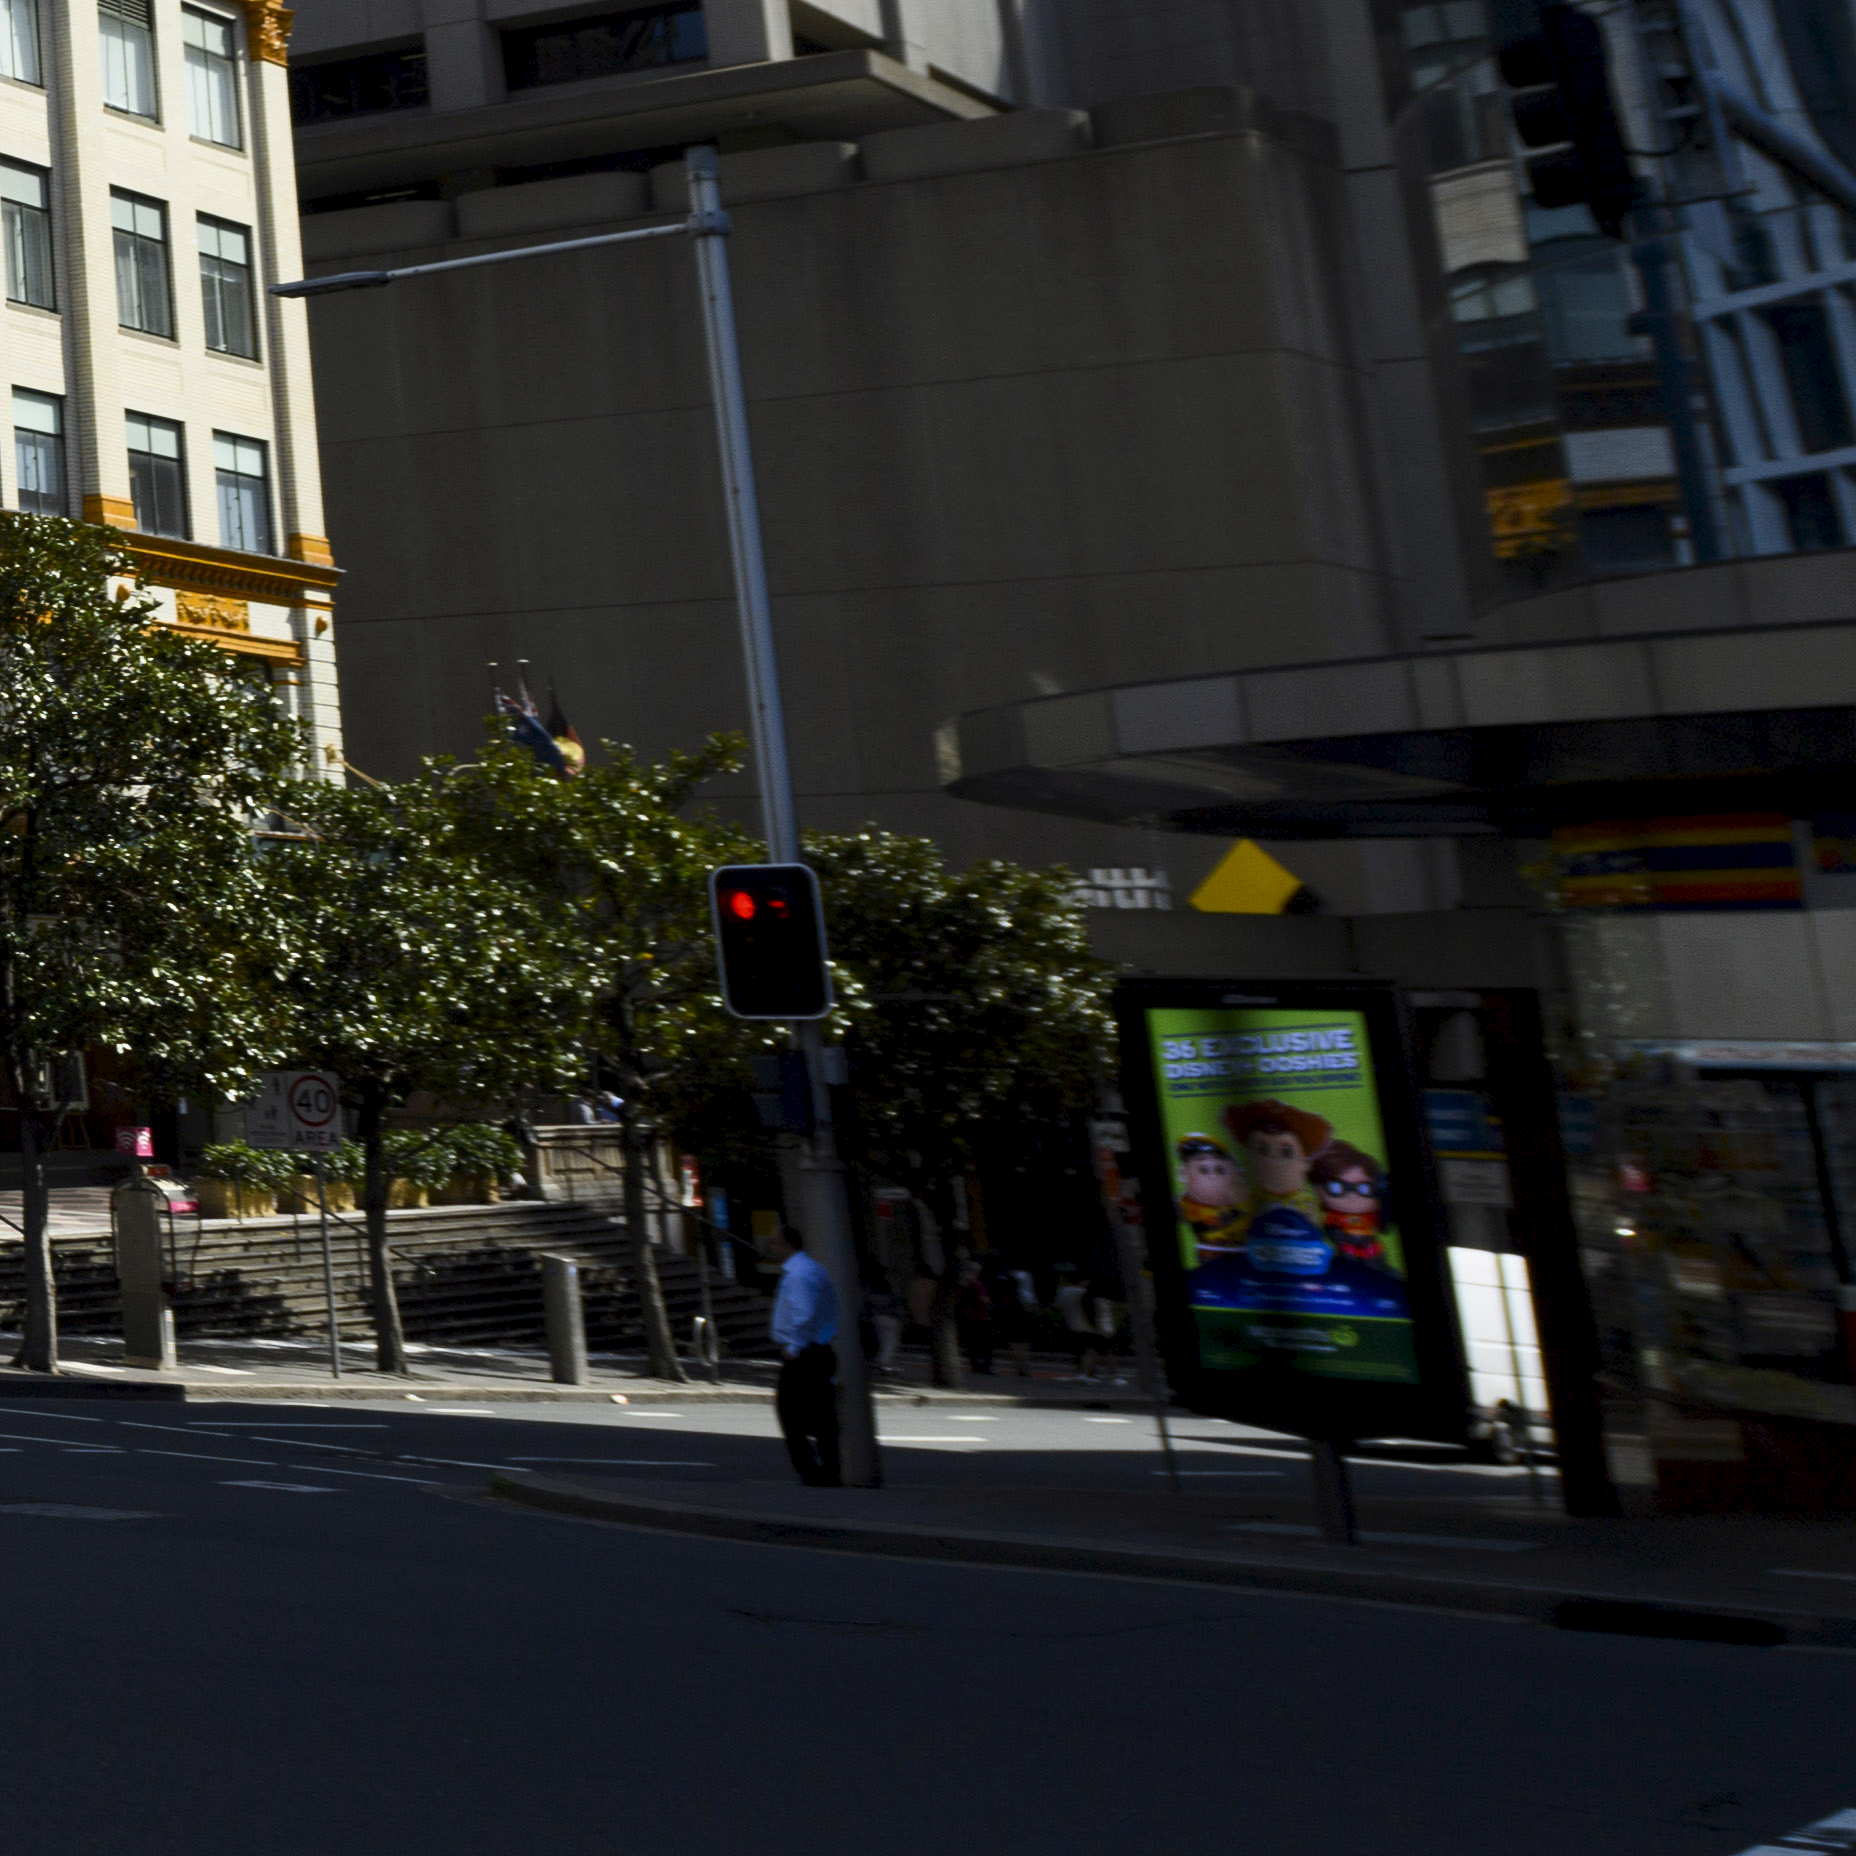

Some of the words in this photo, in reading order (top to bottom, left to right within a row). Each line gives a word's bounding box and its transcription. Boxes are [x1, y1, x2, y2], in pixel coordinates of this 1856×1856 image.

[1162, 1039, 1196, 1060] 36
[1257, 1052, 1359, 1073] OOSHIES
[297, 1088, 331, 1114] 40
[296, 1129, 337, 1146] AREA
